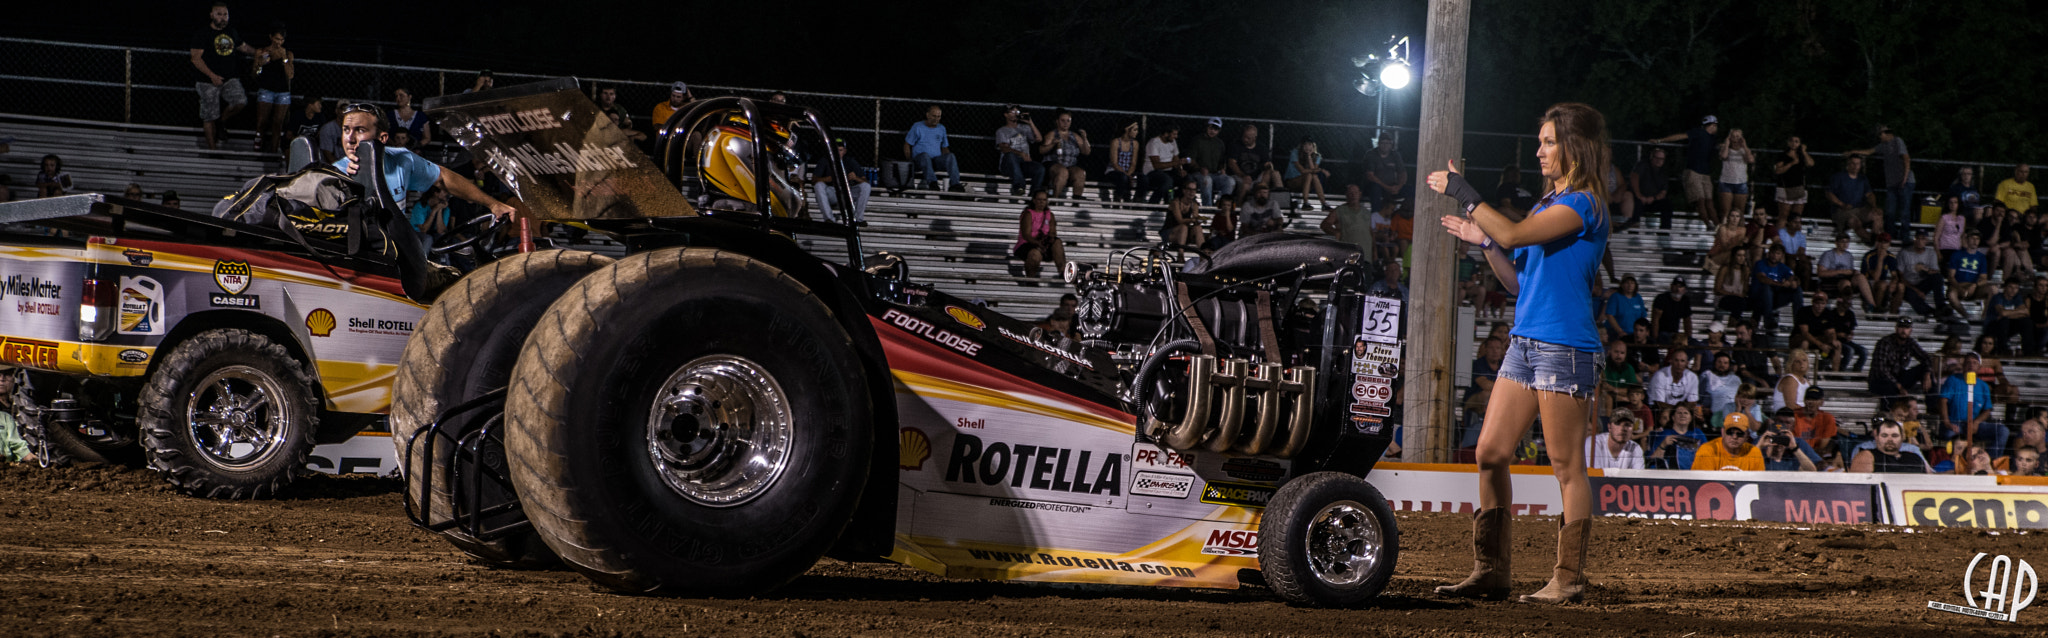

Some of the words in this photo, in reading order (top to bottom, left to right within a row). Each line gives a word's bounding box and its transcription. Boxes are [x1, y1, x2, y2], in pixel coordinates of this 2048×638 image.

[478, 107, 562, 136] FOOTLOOSE
[24, 301, 37, 314] Shell
[213, 296, 244, 306] CASE
[349, 317, 374, 328] Shell
[378, 320, 414, 331] ROTELL
[1365, 309, 1397, 333] 55
[882, 307, 983, 357] FOOTLOOSE
[1033, 339, 1094, 368] ROTELLA
[1366, 353, 1399, 365] Thompson
[1373, 346, 1392, 356] Steve
[957, 417, 985, 430] Shell
[1149, 481, 1176, 489] BMRS
[1218, 486, 1272, 501] RACEPAK
[1600, 484, 1692, 513] POWER
[1784, 500, 1867, 525] MADE
[1206, 529, 1259, 549] MSD
[967, 549, 1196, 578] www.Rotella.com
